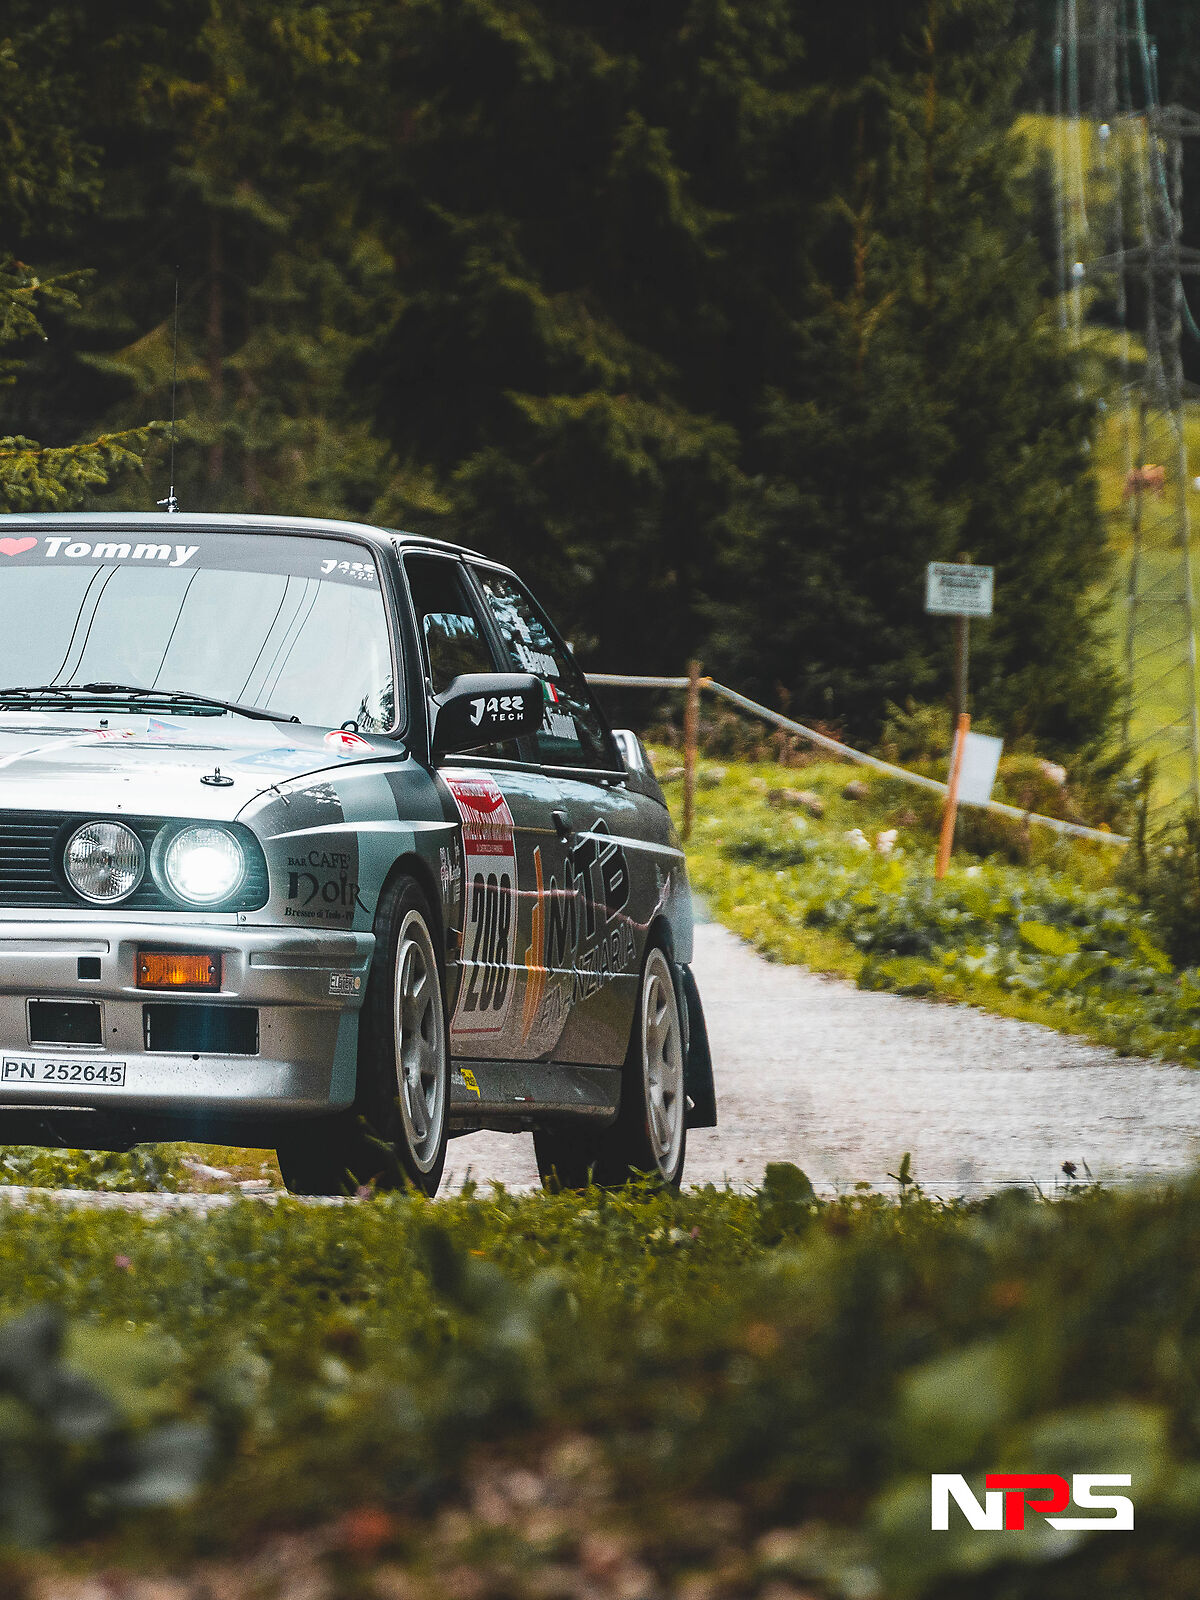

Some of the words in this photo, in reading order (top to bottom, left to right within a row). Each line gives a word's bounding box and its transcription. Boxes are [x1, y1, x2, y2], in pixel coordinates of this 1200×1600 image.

[44, 537, 200, 567] Tommy
[490, 712, 524, 722] TECH
[287, 857, 308, 867] BAR
[462, 872, 512, 1013] 208
[3, 1061, 36, 1079] PN
[43, 1063, 122, 1083] 252645
